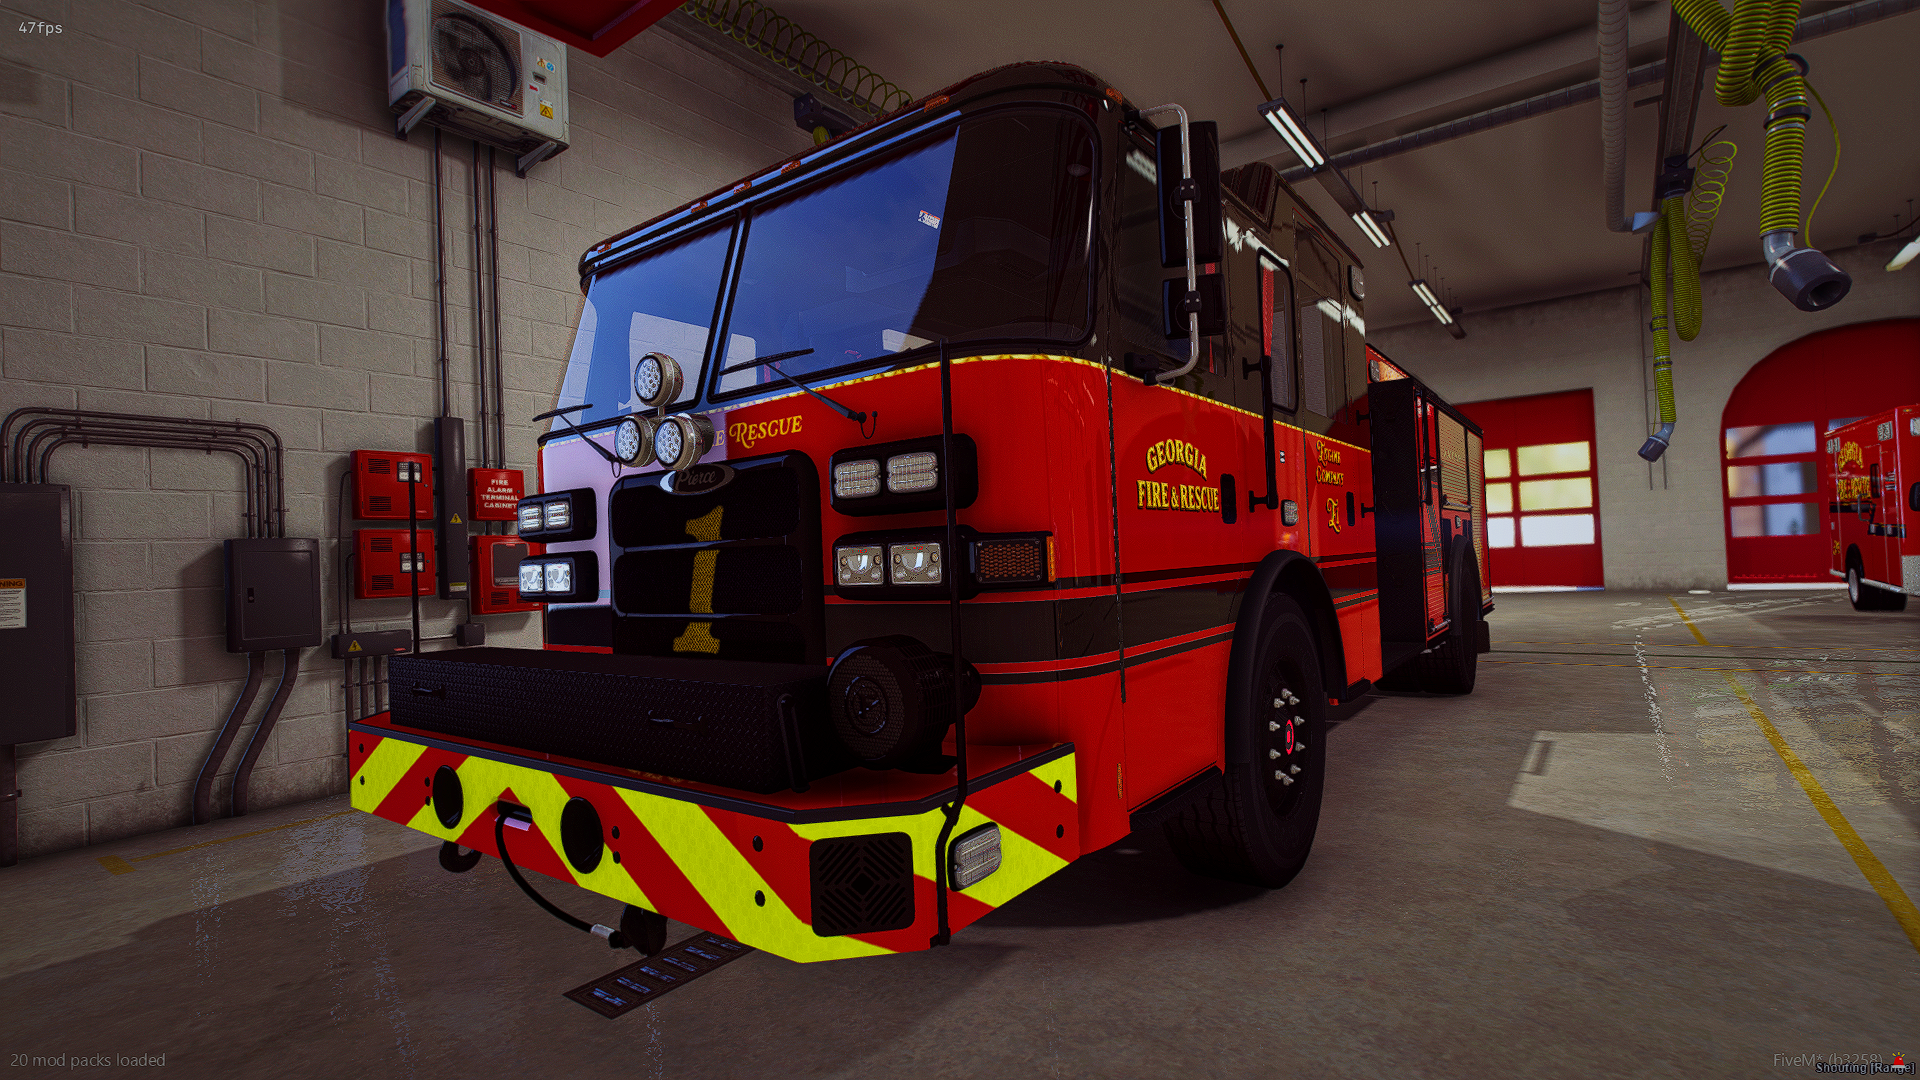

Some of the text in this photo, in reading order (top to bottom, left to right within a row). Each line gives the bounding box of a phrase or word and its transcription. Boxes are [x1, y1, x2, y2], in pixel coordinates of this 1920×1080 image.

[729, 415, 803, 449] RESCUE
[1146, 438, 1207, 482] GEORGIA
[674, 470, 717, 491] Pierce
[1137, 480, 1220, 512] FIRE & RESCUE
[673, 505, 724, 654] 1
